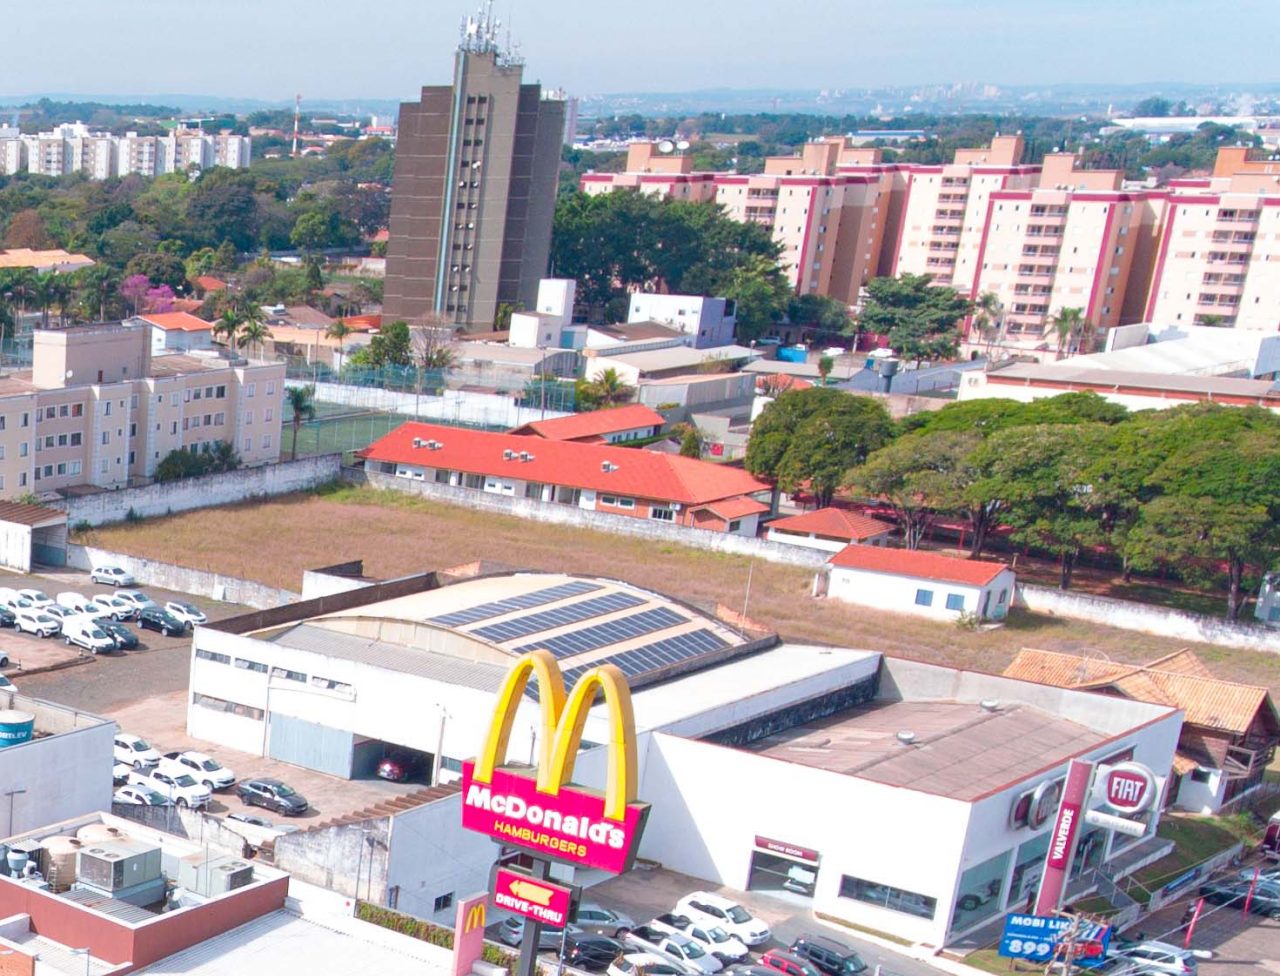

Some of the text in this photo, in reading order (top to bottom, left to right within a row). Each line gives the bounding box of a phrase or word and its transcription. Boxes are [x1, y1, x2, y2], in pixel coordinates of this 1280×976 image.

[1111, 776, 1144, 802] FIAT
[465, 784, 625, 849] McDonald's
[494, 820, 587, 858] HAMBURGERS
[1052, 808, 1074, 860] VALVERDE
[495, 892, 563, 924] DRIVE-THRU
[1010, 916, 1071, 930] MOBI LIK
[1008, 939, 1051, 956] 899
